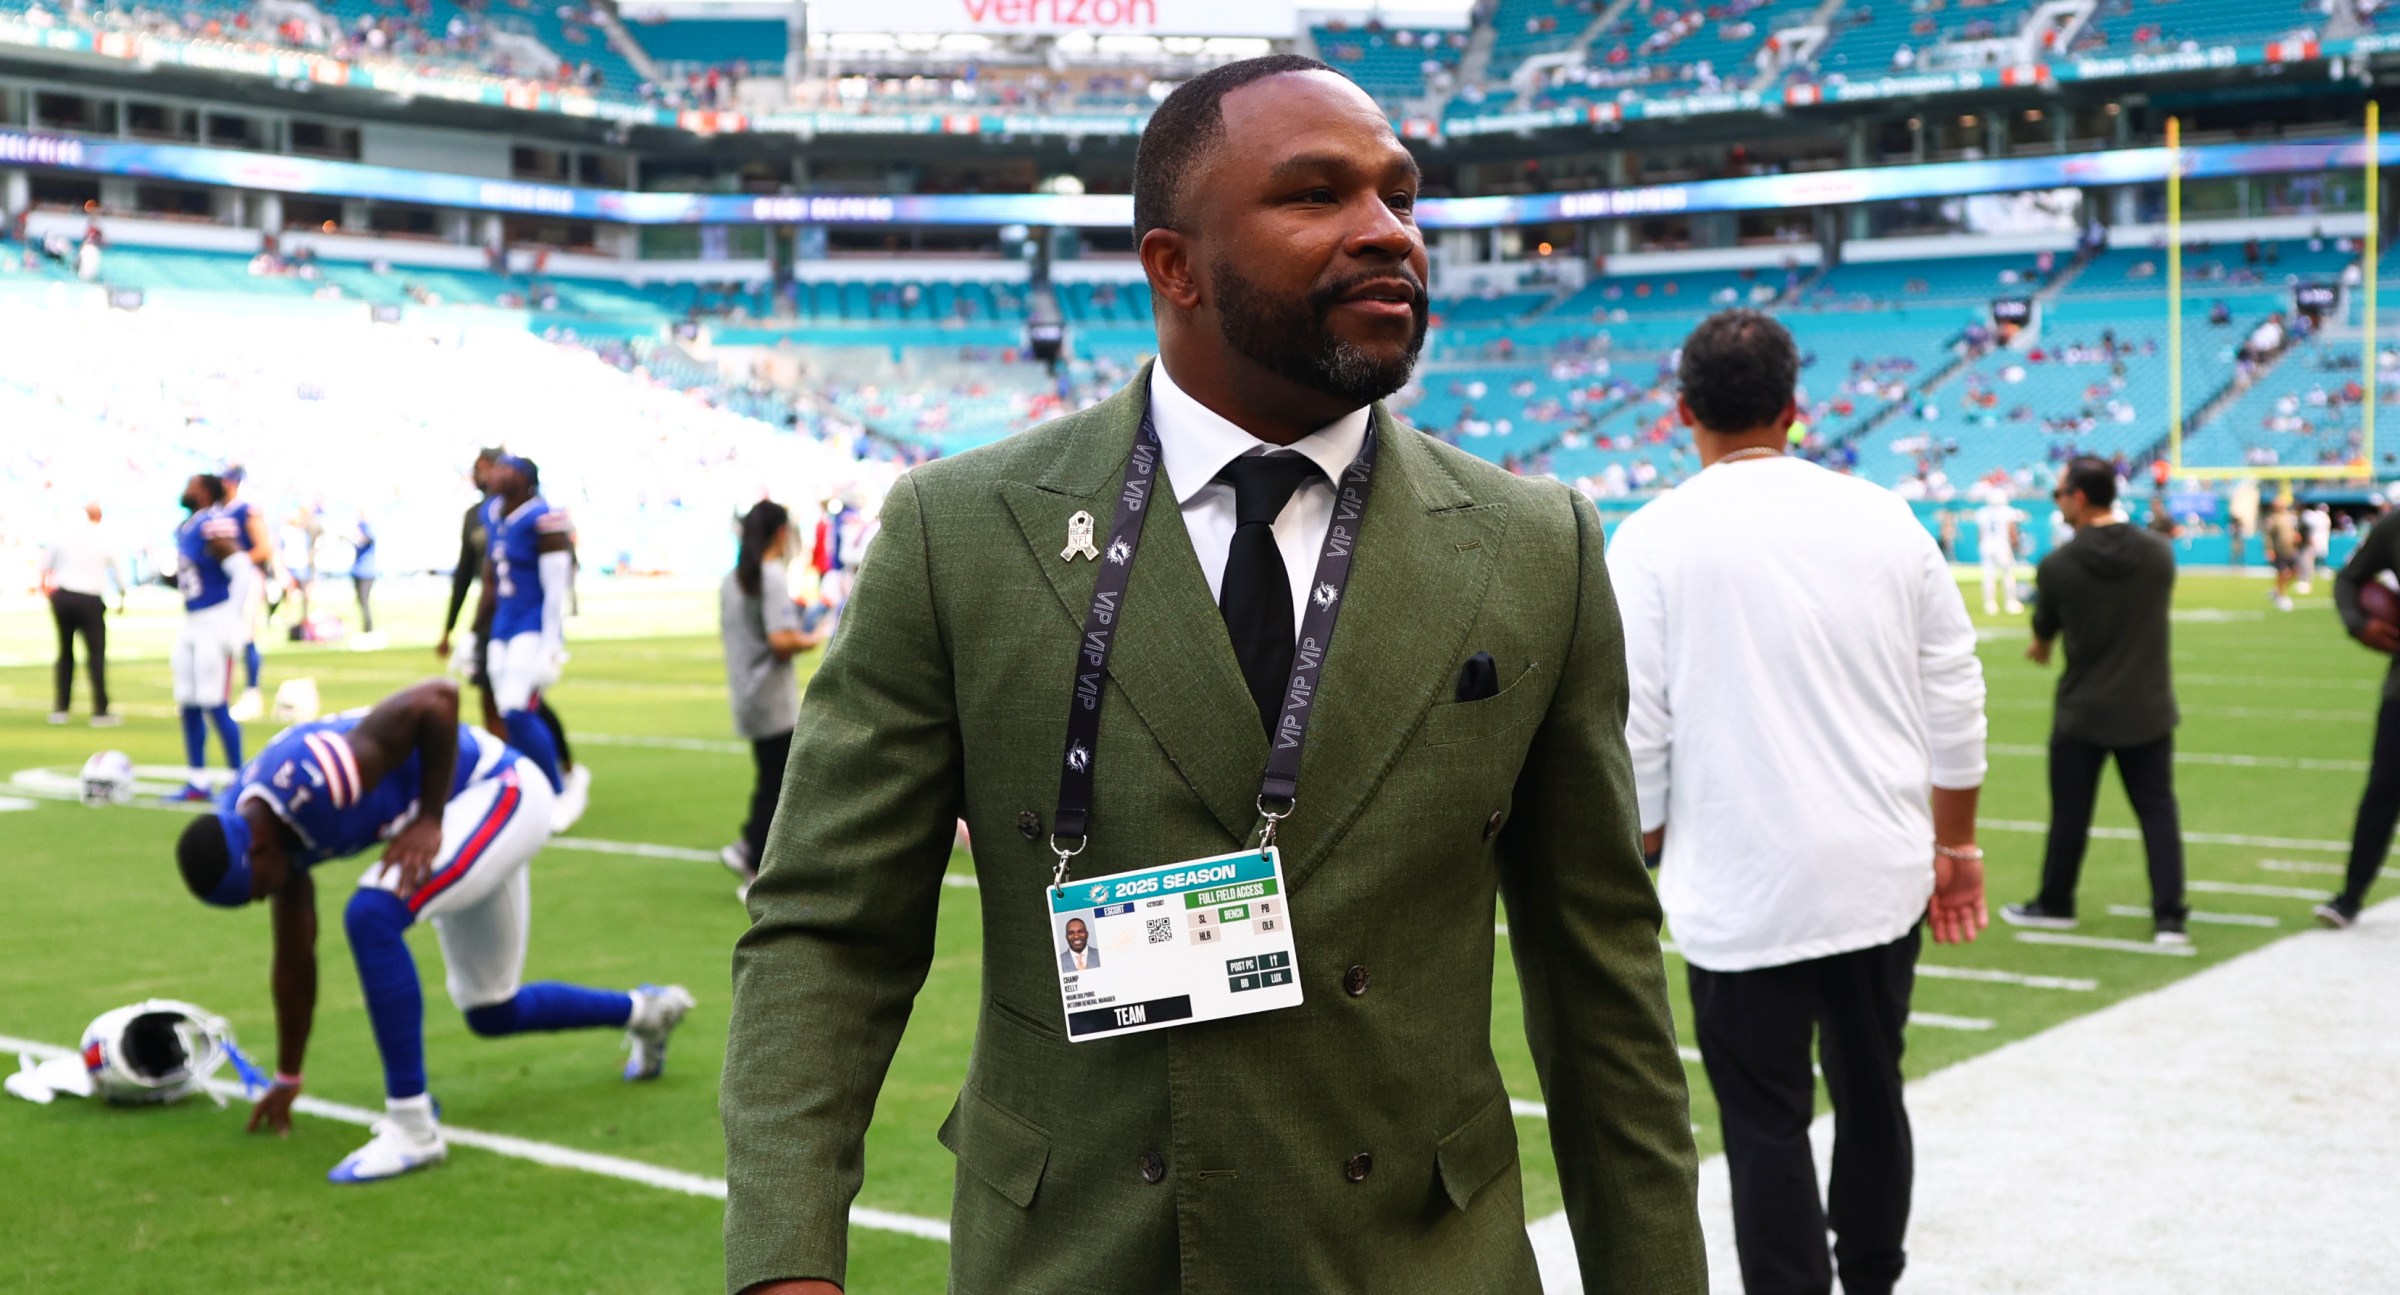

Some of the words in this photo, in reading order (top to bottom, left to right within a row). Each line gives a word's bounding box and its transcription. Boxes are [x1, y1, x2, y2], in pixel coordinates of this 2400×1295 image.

[963, 0, 1158, 26] verizon
[1132, 444, 1156, 475] VIP
[1123, 480, 1147, 511] VIP
[1337, 487, 1363, 520] VIP
[1327, 525, 1352, 557] VIP
[1093, 591, 1118, 625] VIP
[1084, 631, 1108, 667] VIP
[1297, 637, 1322, 670] VIP
[1077, 673, 1100, 710] VIP
[1288, 675, 1311, 710] VIP
[1278, 715, 1302, 749] VIP
[1115, 877, 1159, 898] 2025
[1162, 864, 1236, 889] SEASON
[1198, 891, 1216, 905] FULL
[1216, 888, 1236, 902] FIELD
[1236, 883, 1264, 899] ACCESS
[1198, 914, 1206, 924] SL
[1223, 907, 1245, 920] BENCH
[1261, 903, 1270, 914] PB
[1198, 930, 1212, 942] HLR
[1063, 975, 1079, 984] CHAMP
[1230, 961, 1245, 972] POST
[1245, 959, 1255, 970] PC
[1064, 984, 1078, 993] KELLY
[1113, 1004, 1147, 1026] TEAM
